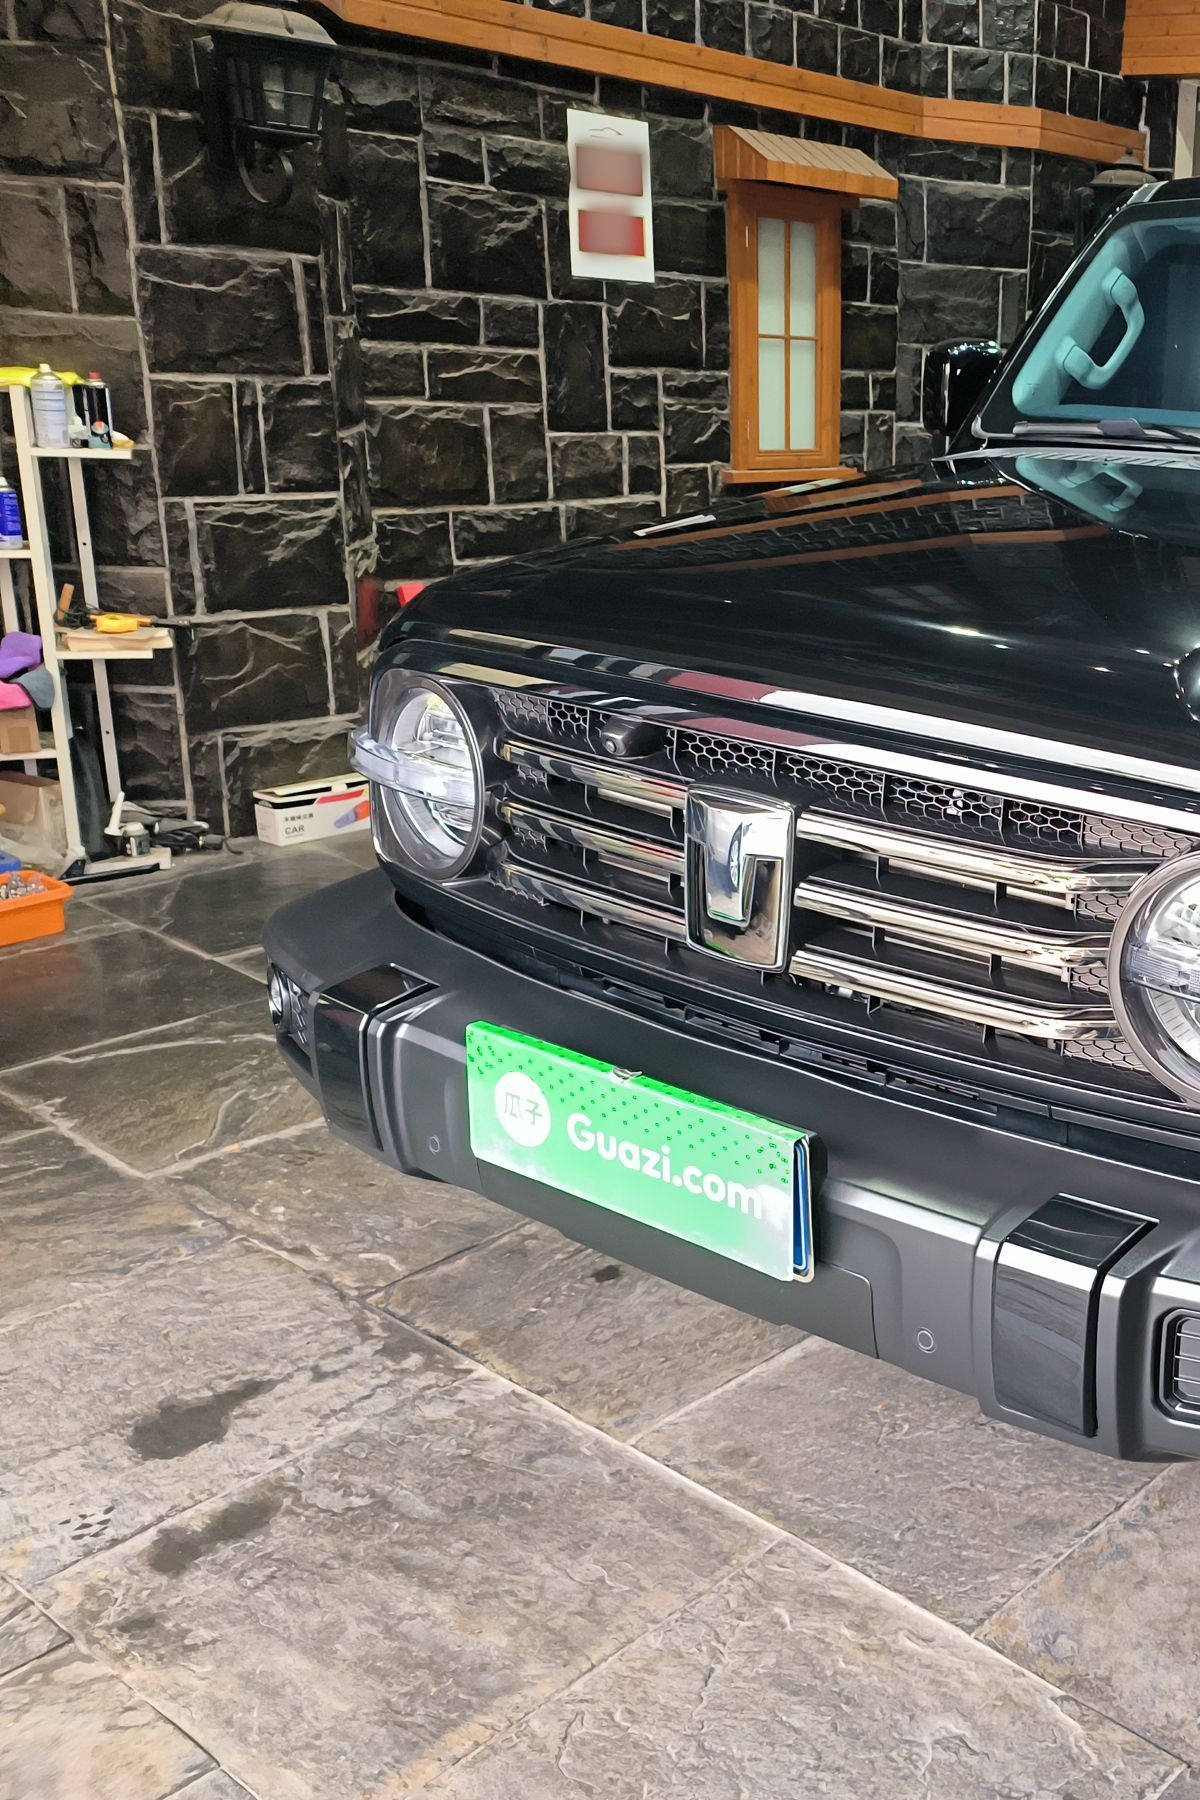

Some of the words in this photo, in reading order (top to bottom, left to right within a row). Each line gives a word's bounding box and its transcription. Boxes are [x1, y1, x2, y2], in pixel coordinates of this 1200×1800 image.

[285, 825, 305, 835] CAR
[502, 1091, 545, 1126] 瓜子
[566, 1112, 764, 1220] Guazi.com
